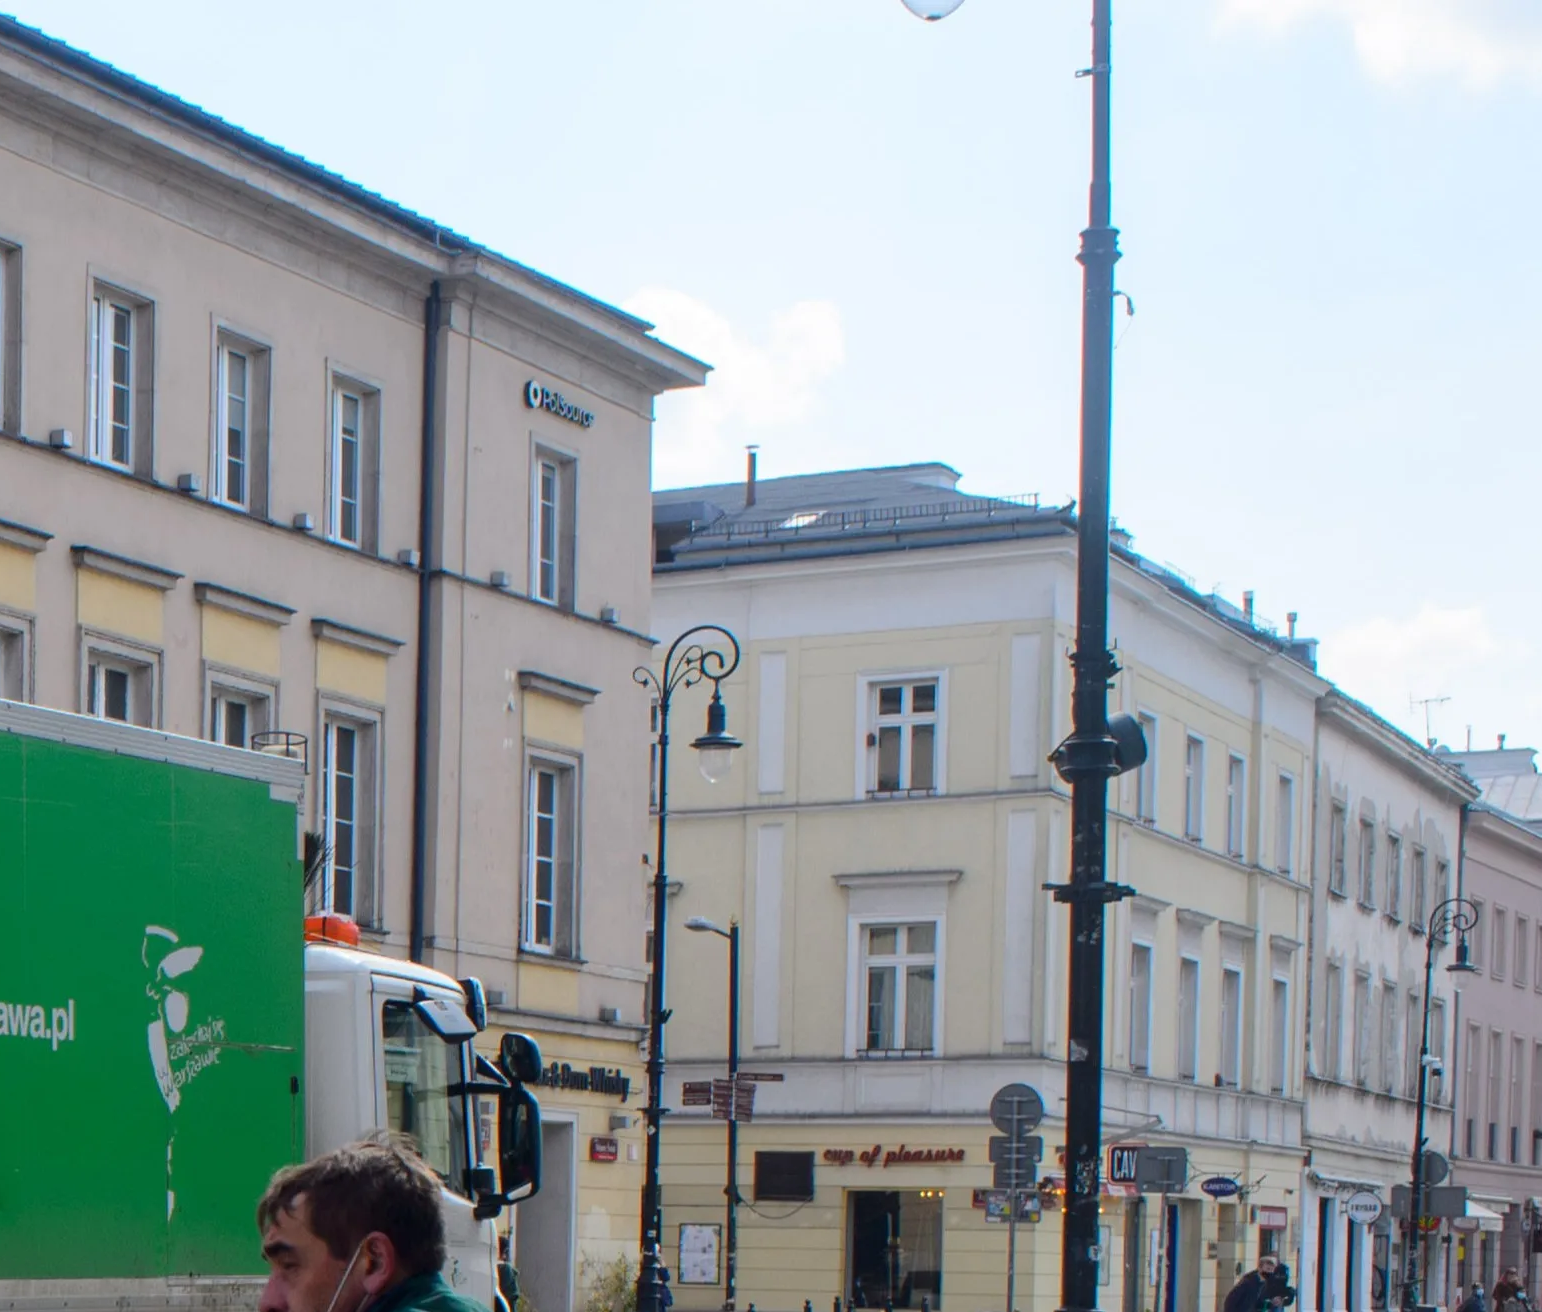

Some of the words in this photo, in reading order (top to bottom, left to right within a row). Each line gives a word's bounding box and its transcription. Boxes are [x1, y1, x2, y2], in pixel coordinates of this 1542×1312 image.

[860, 1144, 881, 1168] of
[883, 1144, 965, 1168] pleasure
[1114, 1150, 1138, 1181] CAV
